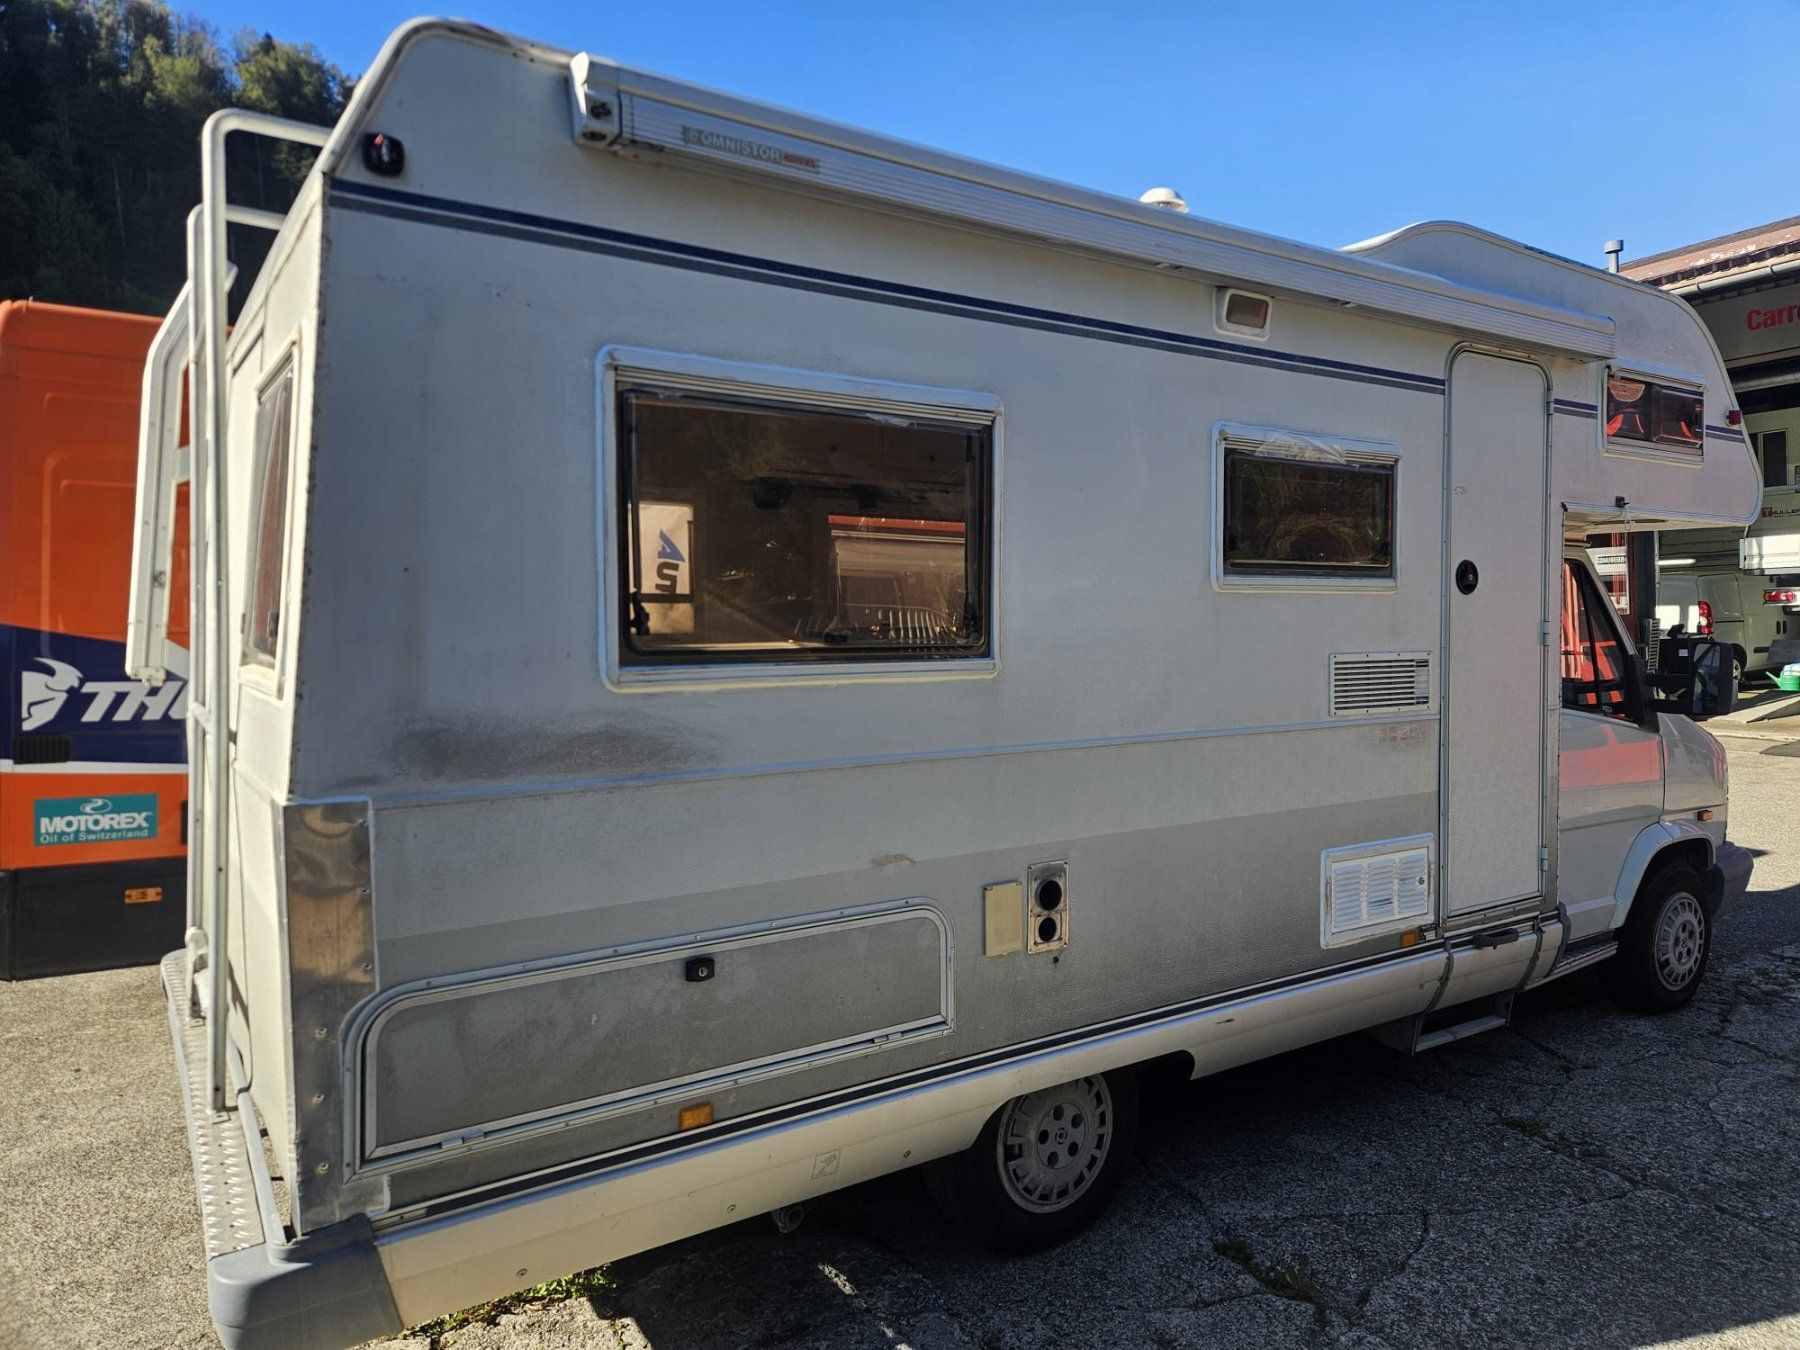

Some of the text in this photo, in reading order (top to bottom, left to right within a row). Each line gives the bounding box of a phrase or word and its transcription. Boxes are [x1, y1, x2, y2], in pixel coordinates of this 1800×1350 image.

[701, 131, 781, 162] OMNISTOR
[40, 812, 150, 834] MOTOREX
[40, 828, 149, 844] Oil of Switzerland
